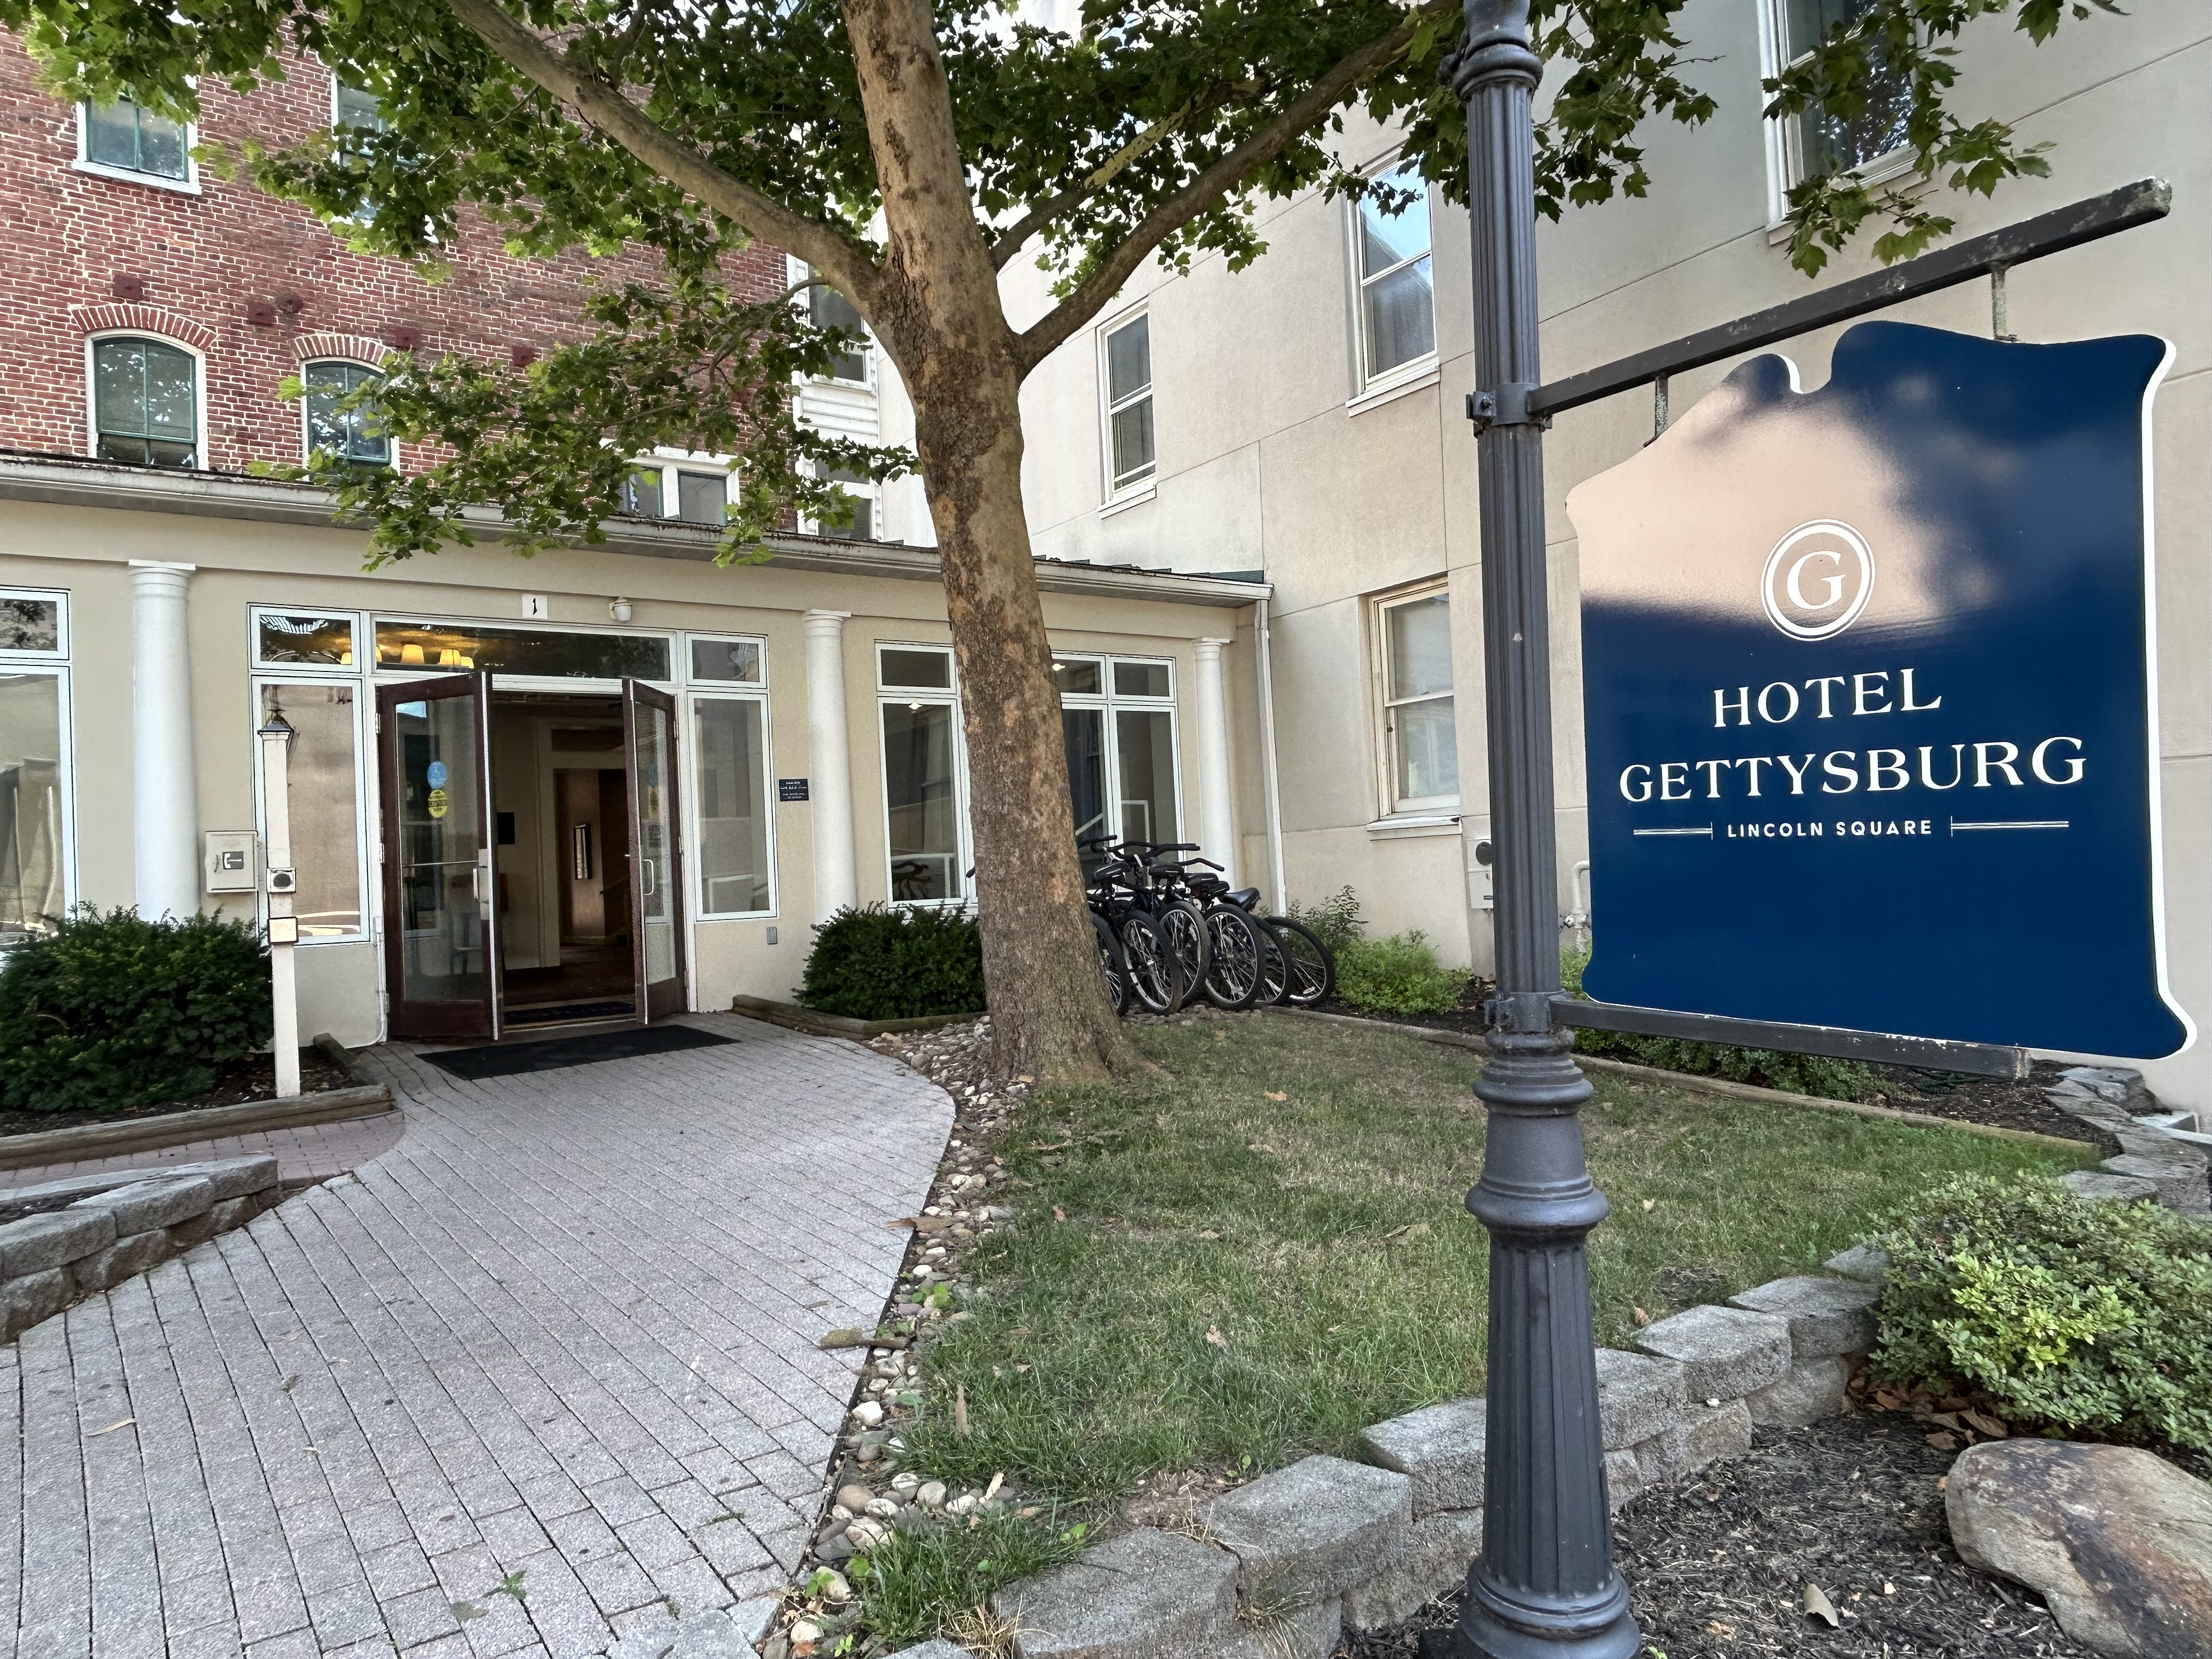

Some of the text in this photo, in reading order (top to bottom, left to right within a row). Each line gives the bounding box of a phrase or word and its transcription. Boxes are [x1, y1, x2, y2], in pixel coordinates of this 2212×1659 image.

[1787, 550, 1846, 610] G
[1714, 669, 1942, 727] HOTEL
[1620, 737, 2086, 802] GETTYSBURG
[1728, 820, 1932, 837] LINCOLN SQUARE
